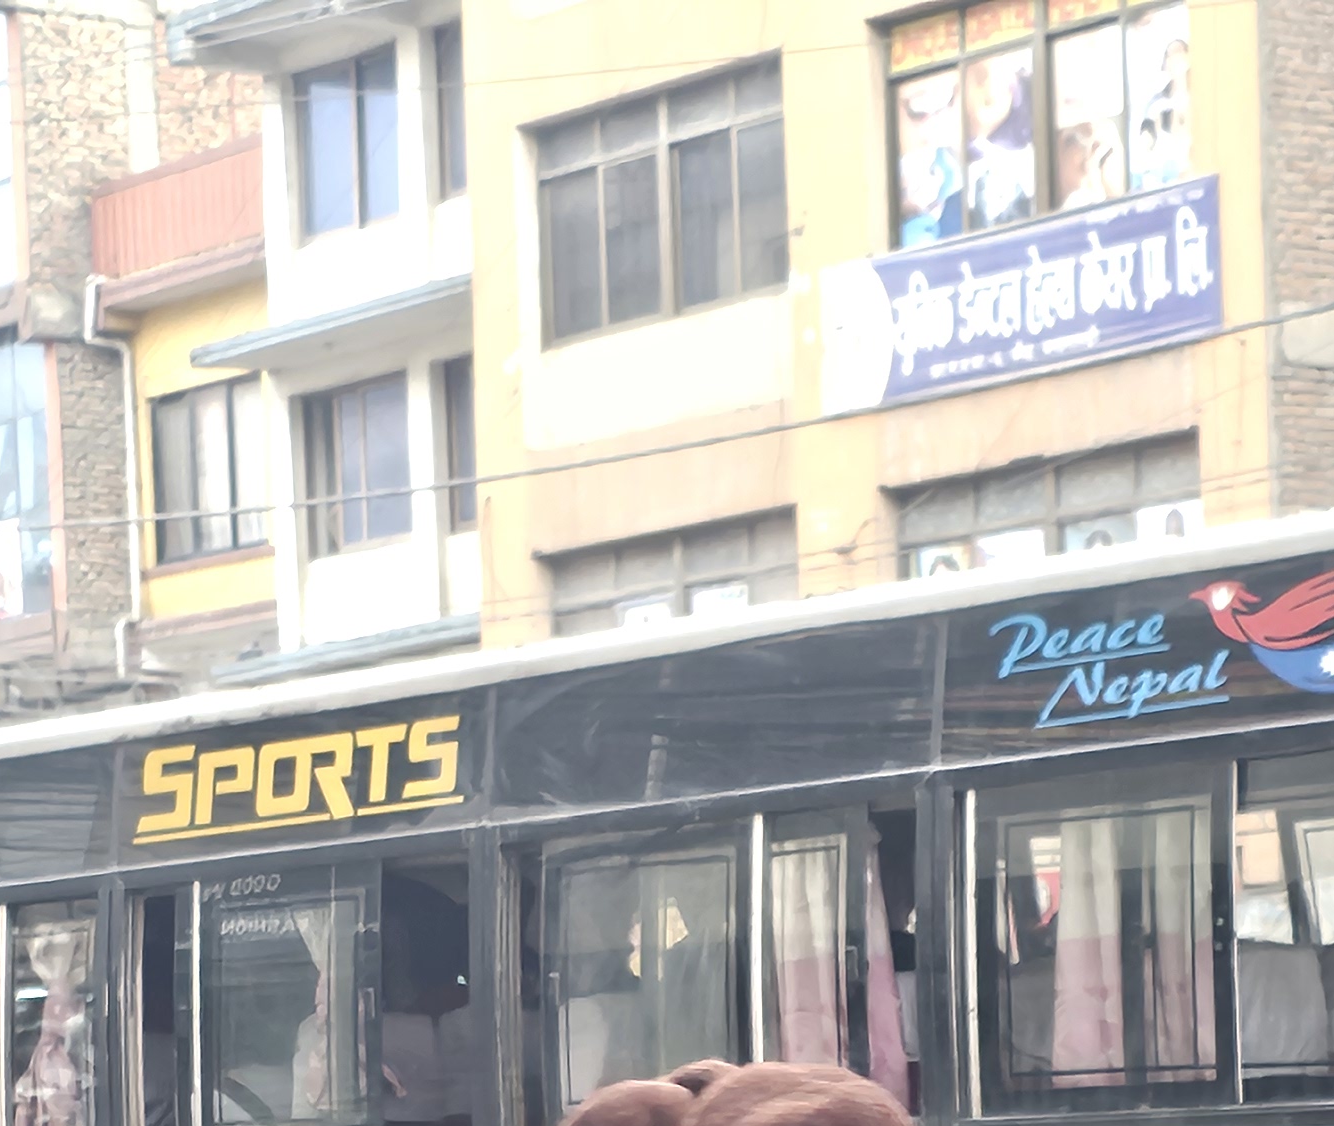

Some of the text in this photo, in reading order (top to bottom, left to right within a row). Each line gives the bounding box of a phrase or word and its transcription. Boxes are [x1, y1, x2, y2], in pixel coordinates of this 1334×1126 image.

[989, 610, 1169, 679] Peace
[1034, 650, 1229, 728] Nepal
[134, 714, 463, 841] SPORTS
